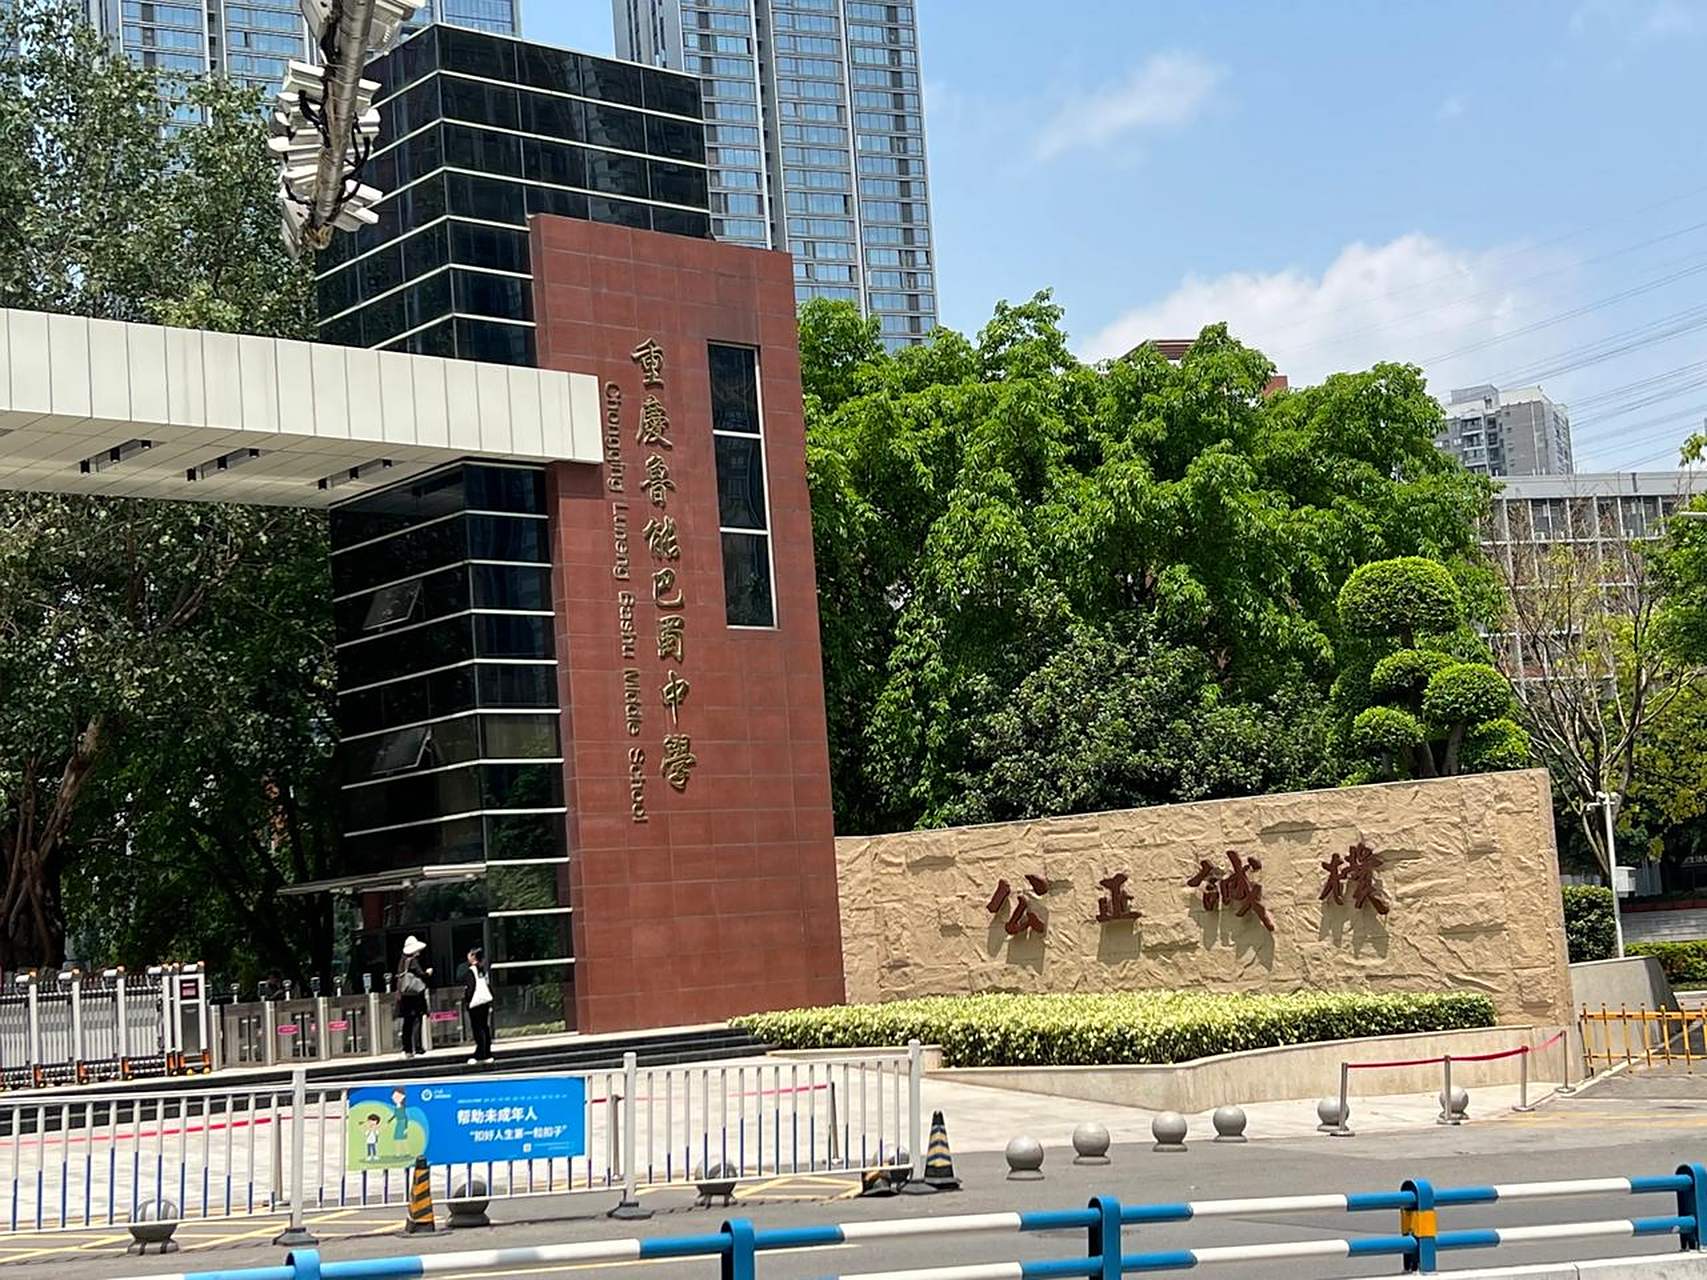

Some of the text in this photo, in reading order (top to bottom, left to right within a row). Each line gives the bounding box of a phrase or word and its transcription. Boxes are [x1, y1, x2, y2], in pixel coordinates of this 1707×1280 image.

[604, 381, 648, 824] Chongqing Luneng Bashu Middle School
[456, 1106, 538, 1126] 帮助未成年人
